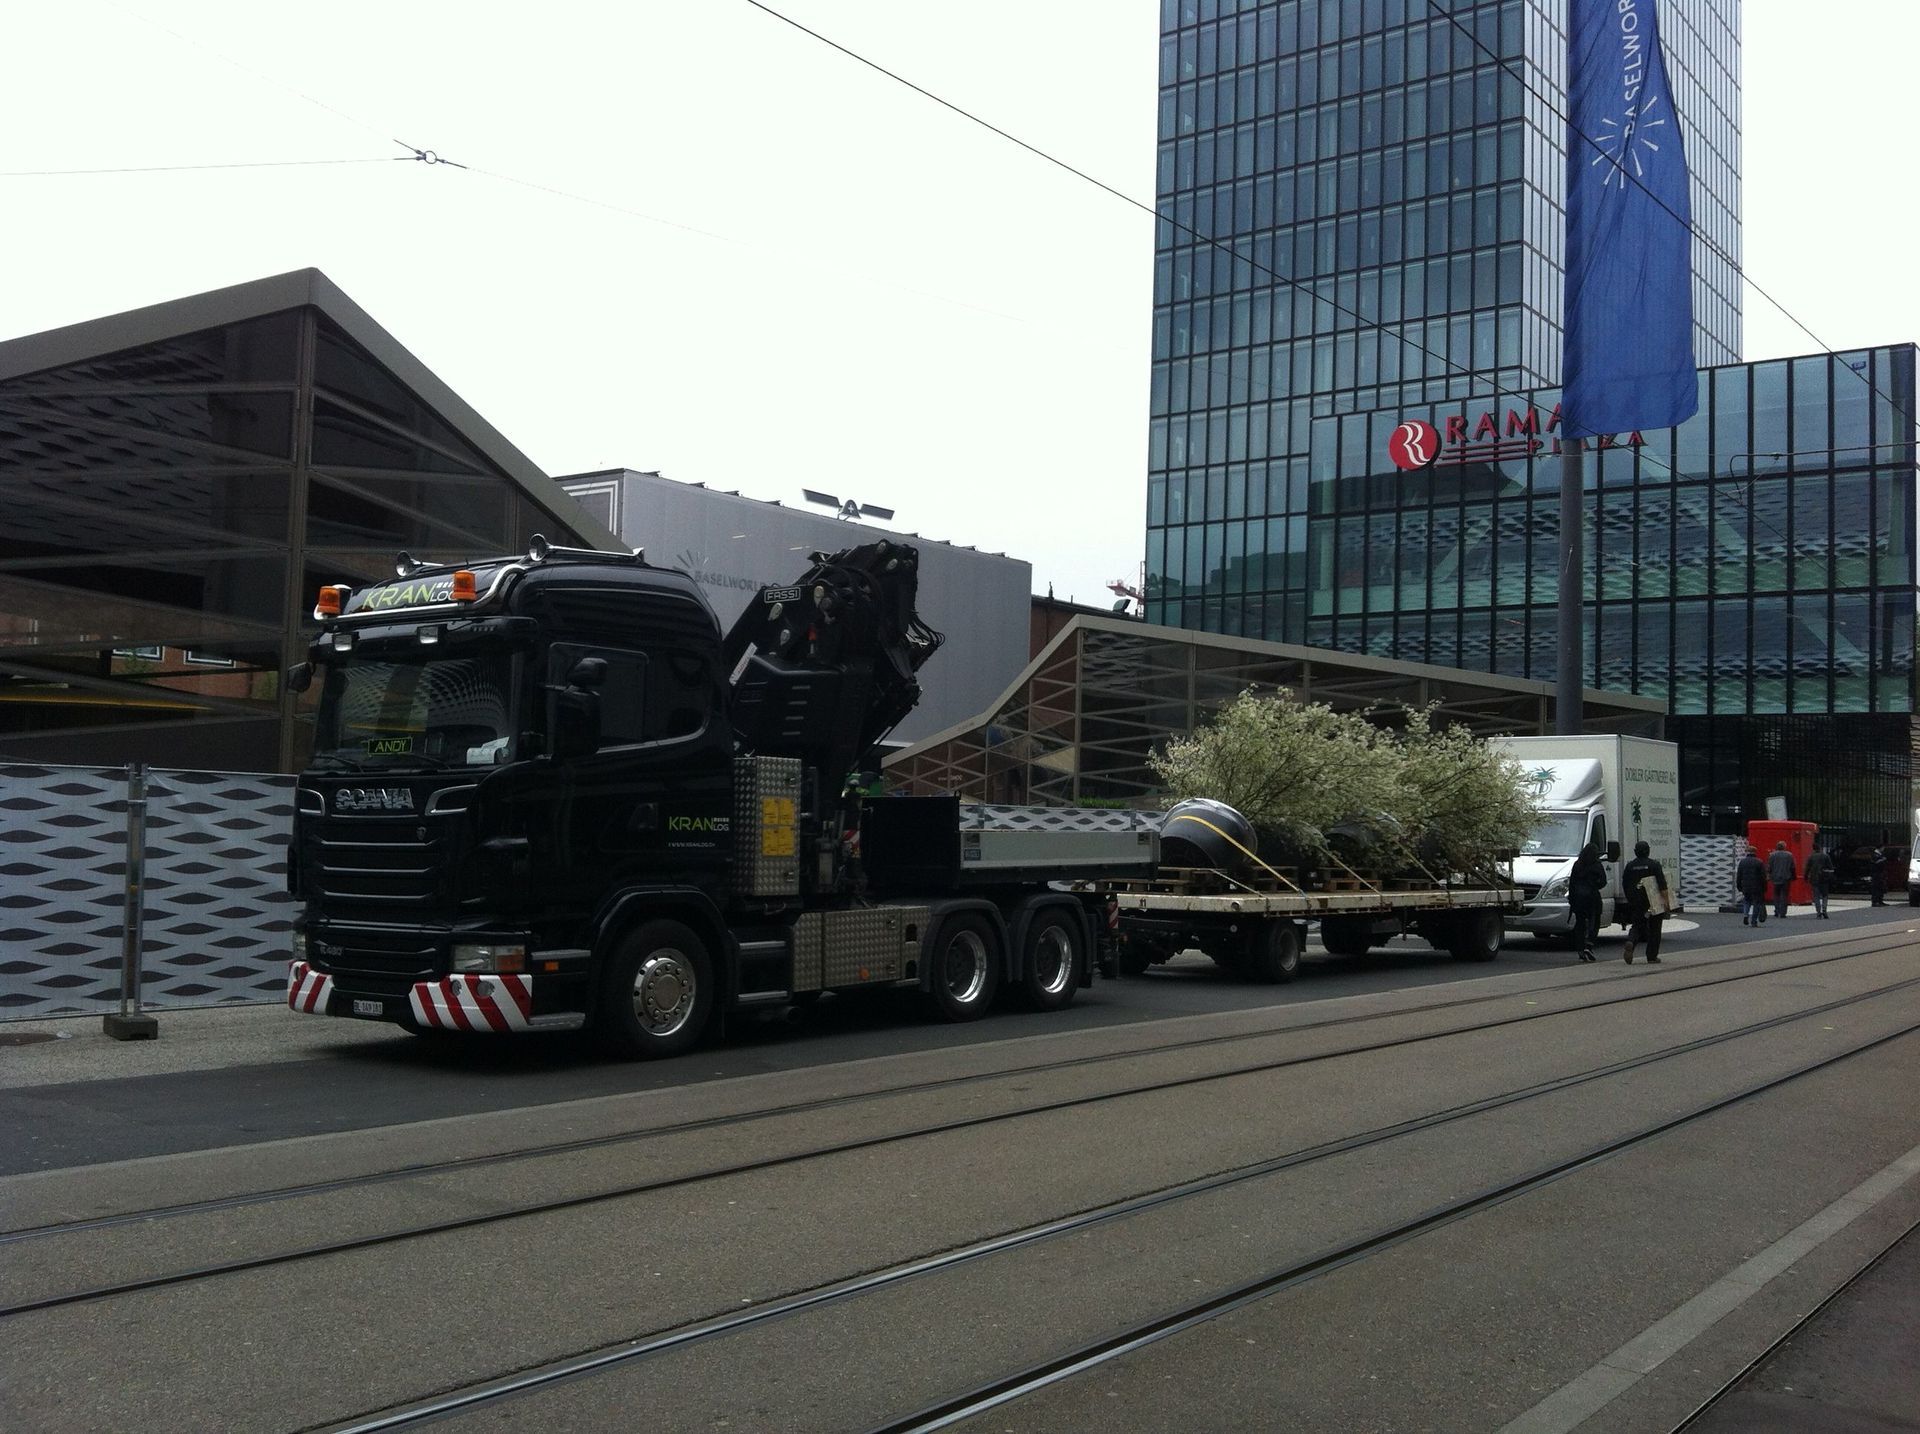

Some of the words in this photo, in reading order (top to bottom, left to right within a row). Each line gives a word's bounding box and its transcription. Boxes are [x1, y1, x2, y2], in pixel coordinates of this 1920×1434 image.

[1446, 402, 1562, 444] RAMA
[1528, 430, 1648, 455] PLZA
[361, 582, 436, 610] KRAN
[766, 589, 798, 601] FASSI
[374, 739, 407, 753] ANDY
[335, 788, 415, 810] SCANIA
[668, 816, 714, 831] KRAN
[713, 823, 730, 832] LOG
